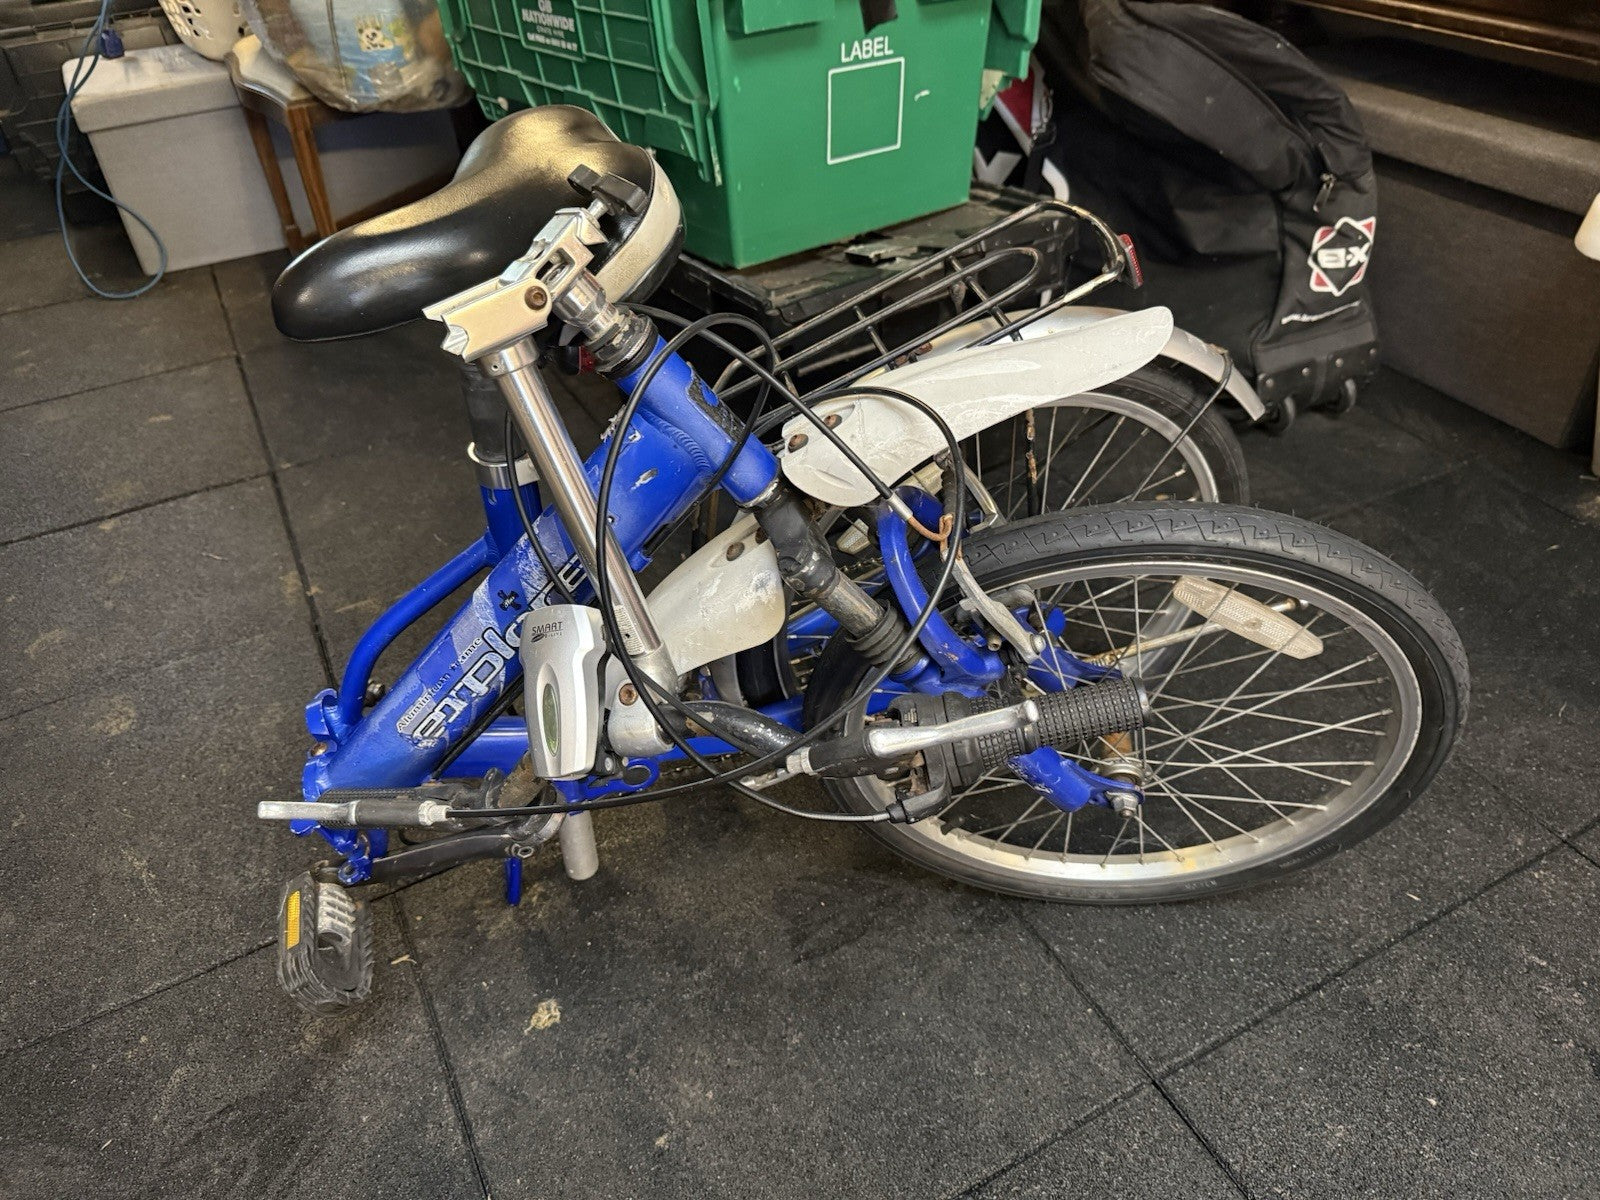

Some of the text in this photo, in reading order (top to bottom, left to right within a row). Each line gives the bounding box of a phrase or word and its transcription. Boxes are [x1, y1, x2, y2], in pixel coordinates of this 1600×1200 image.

[521, 8, 575, 32] NATIONWIDE
[841, 36, 894, 63] LABEL
[531, 621, 563, 635] SMART
[396, 672, 451, 733] Aluminium
